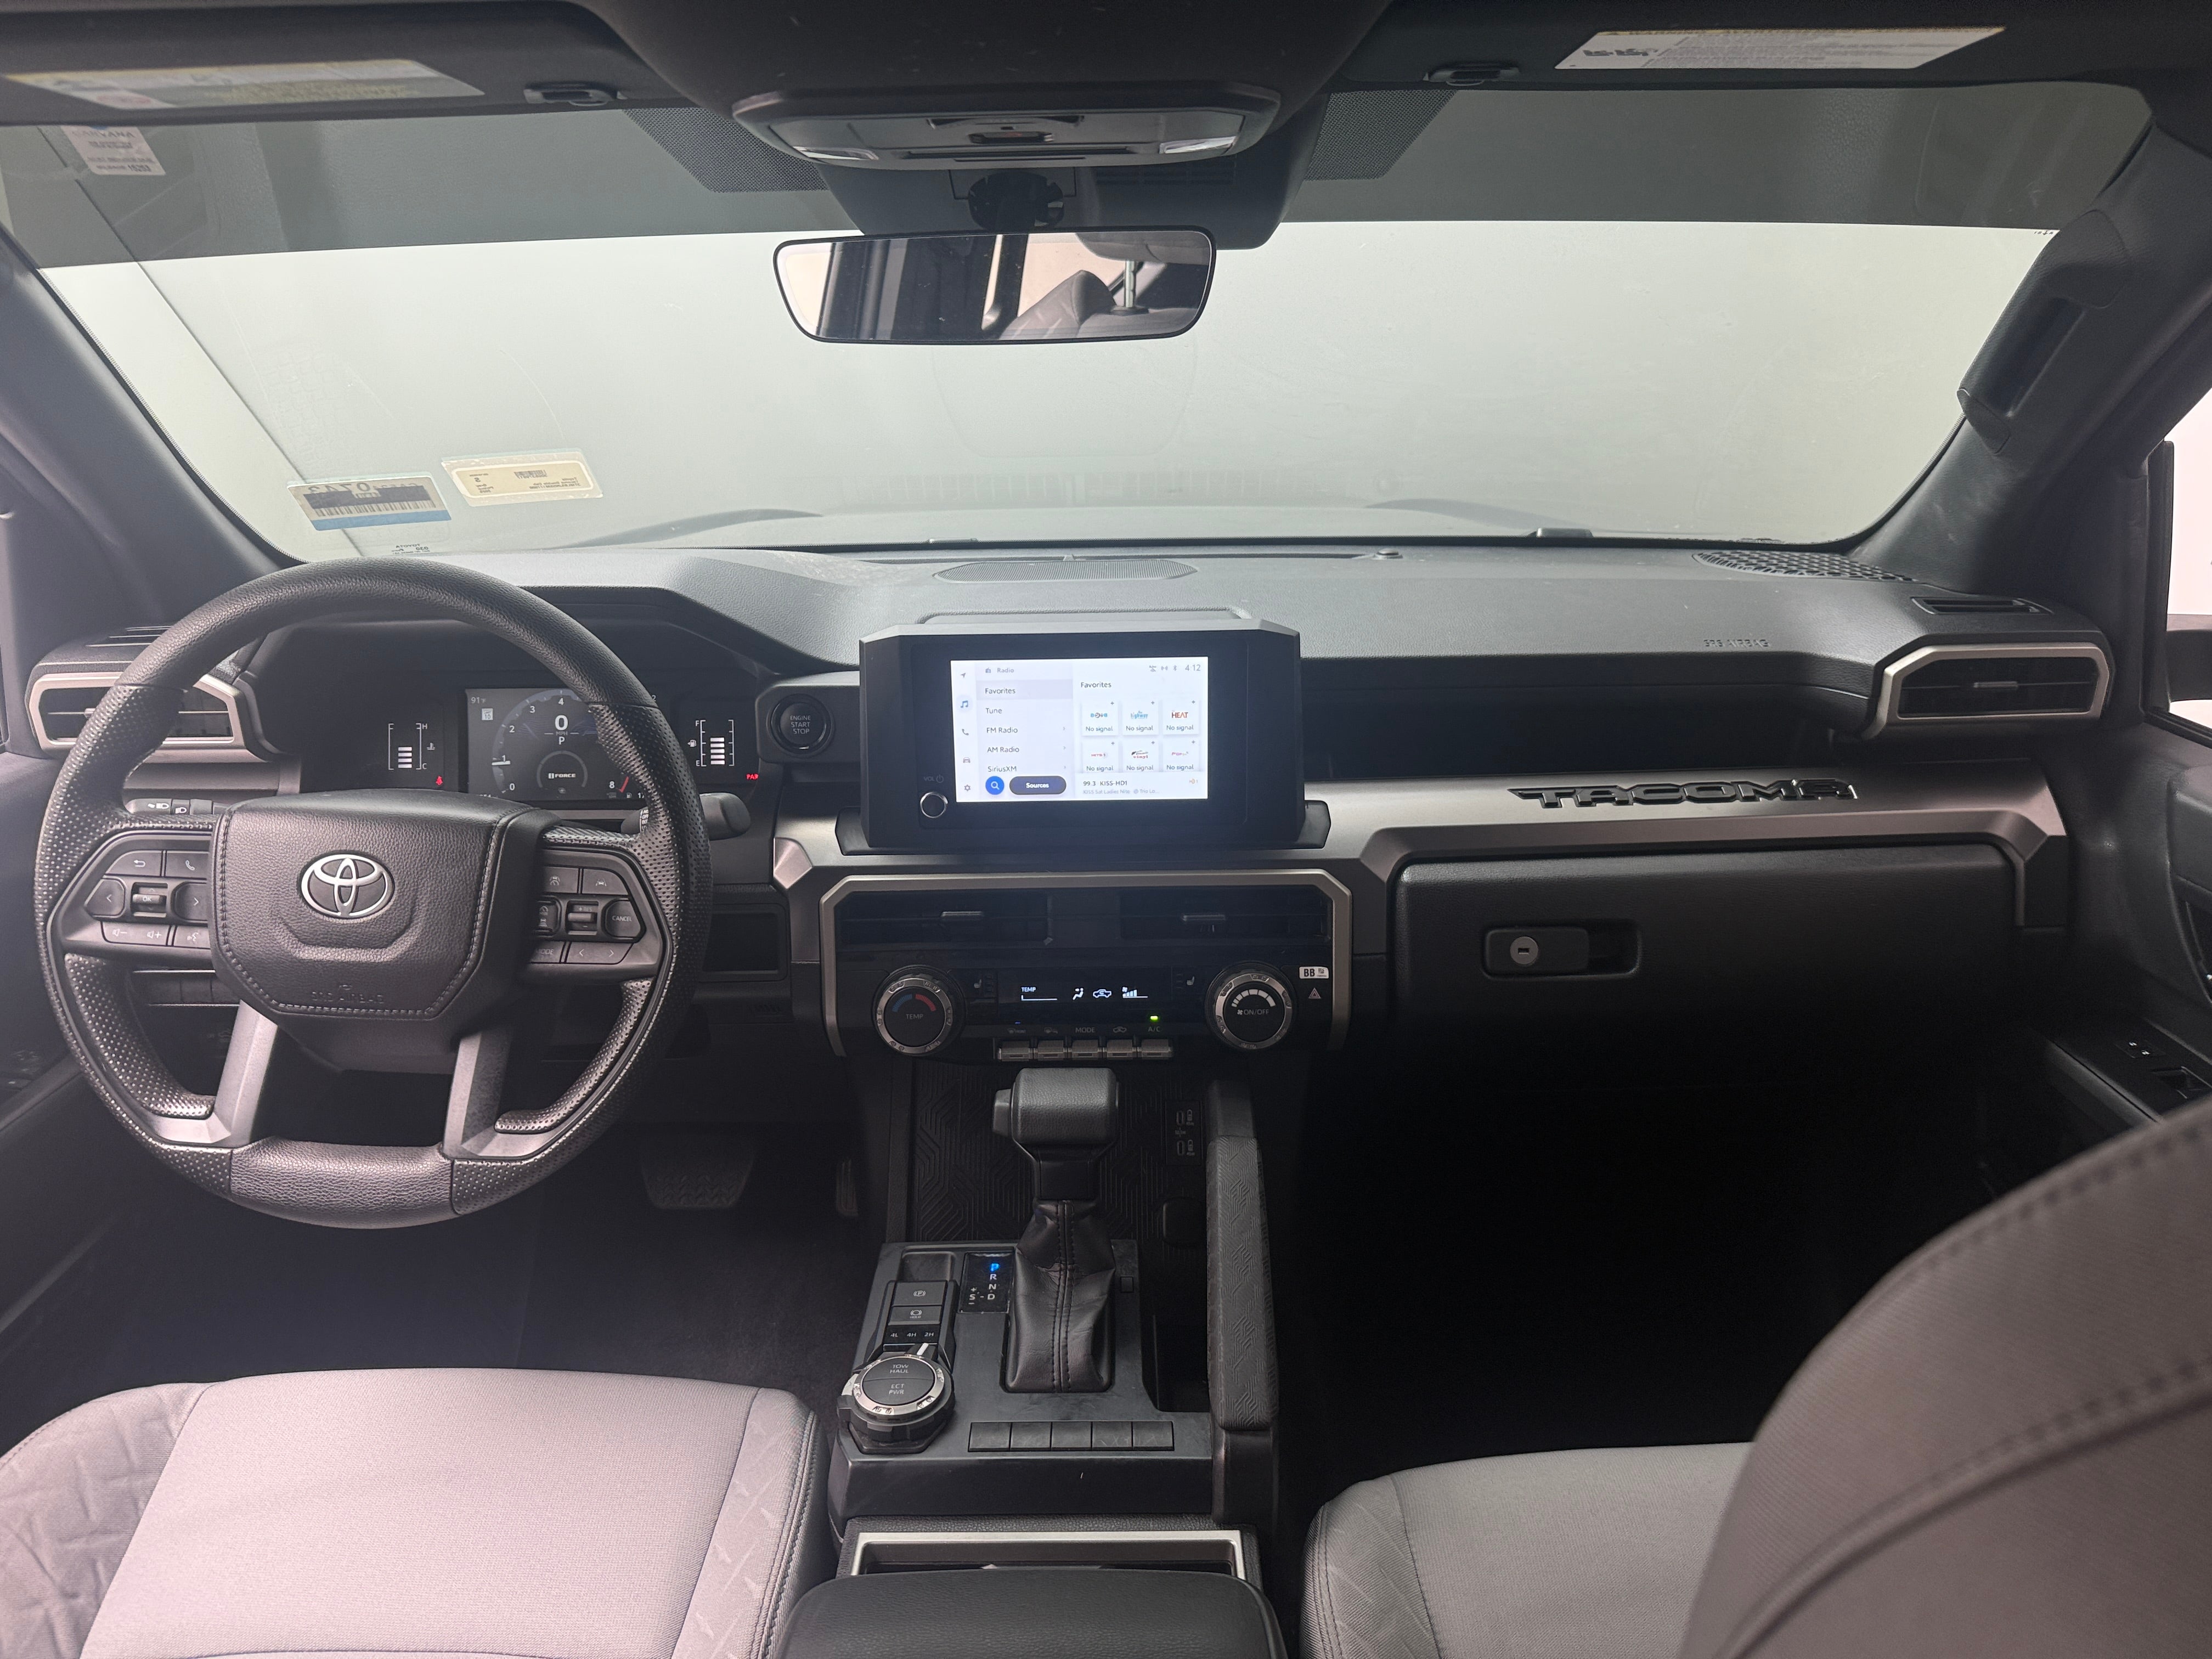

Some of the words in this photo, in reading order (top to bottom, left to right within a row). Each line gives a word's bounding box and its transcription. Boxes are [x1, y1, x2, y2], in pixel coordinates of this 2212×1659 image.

[555, 715, 568, 731] 0
[1507, 778, 1858, 809] TACOMA
[1304, 968, 1316, 977] BB
[990, 1262, 1000, 1272] P
